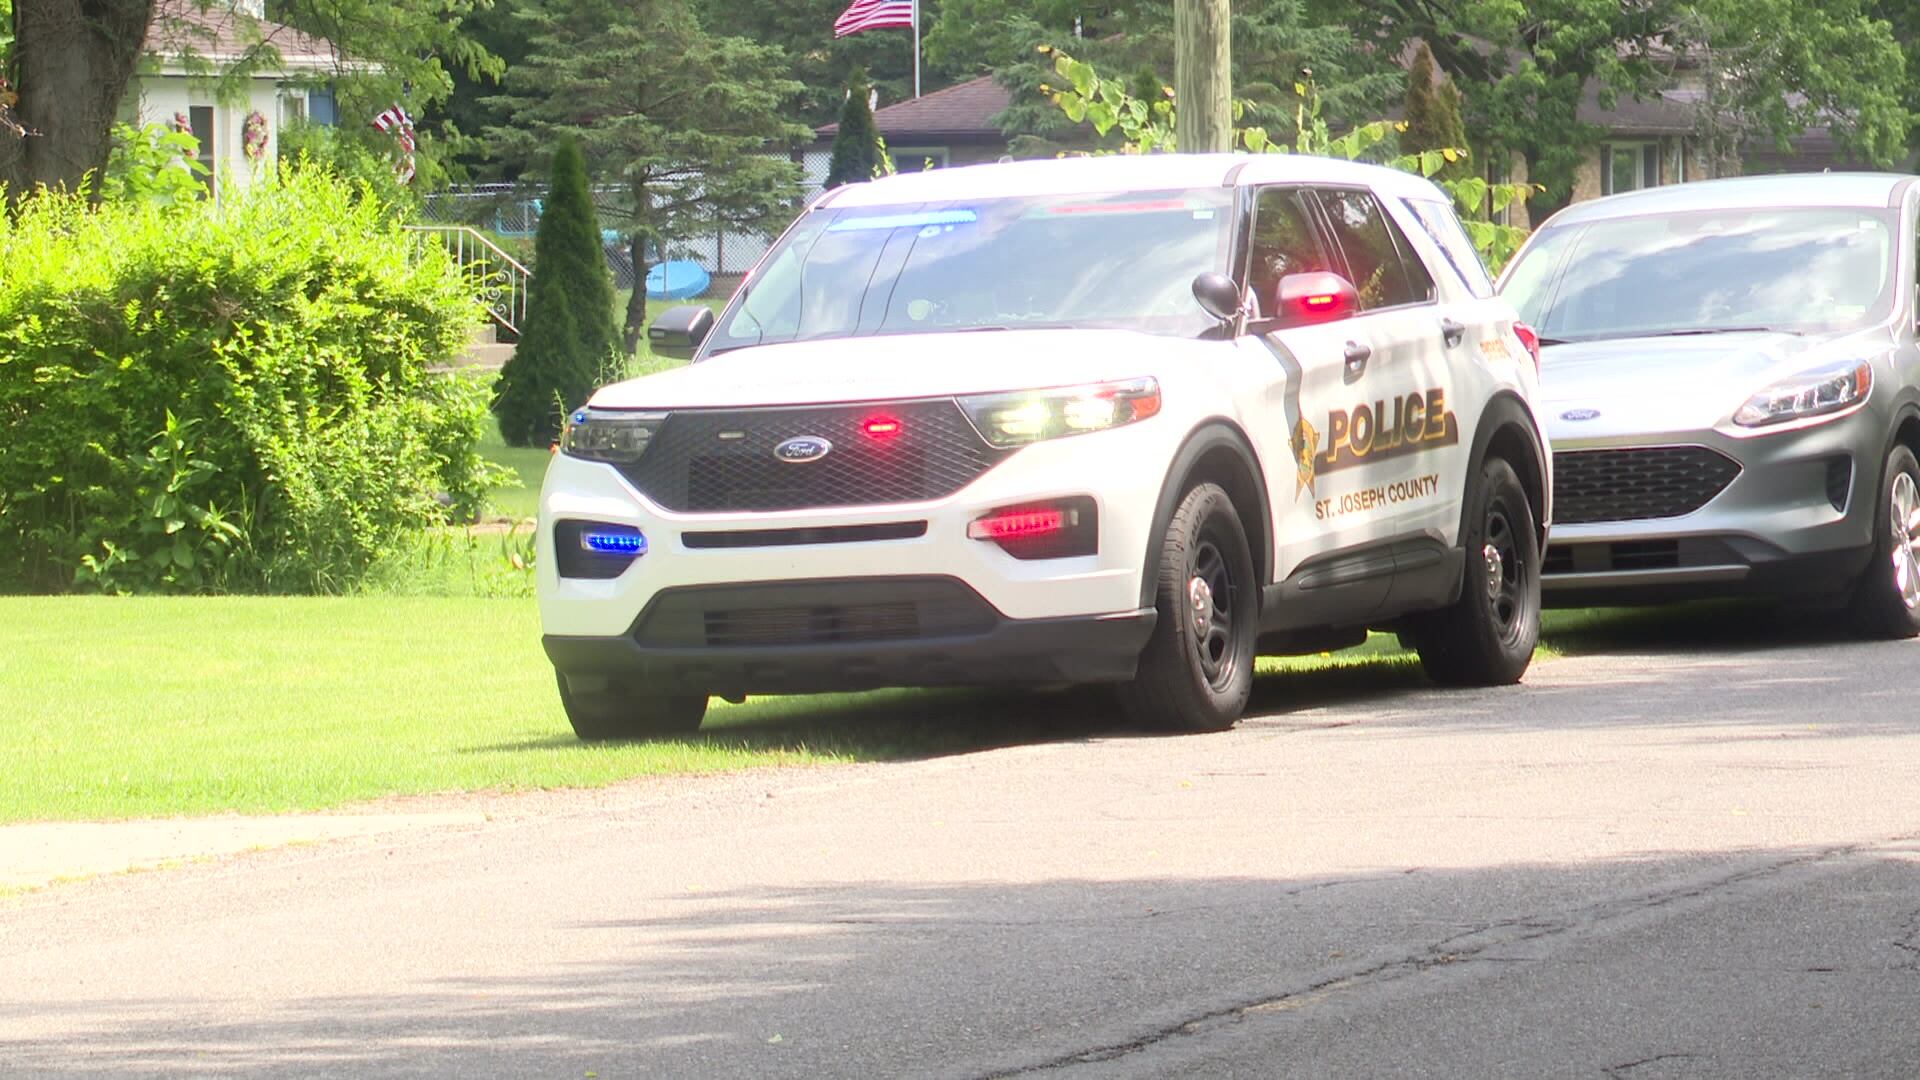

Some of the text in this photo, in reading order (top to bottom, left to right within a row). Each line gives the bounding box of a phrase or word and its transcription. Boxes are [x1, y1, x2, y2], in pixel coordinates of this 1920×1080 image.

[1326, 387, 1447, 463] POLICE
[785, 442, 815, 457] Ford
[1315, 474, 1439, 520] ST. JOSEPH COUNTY
